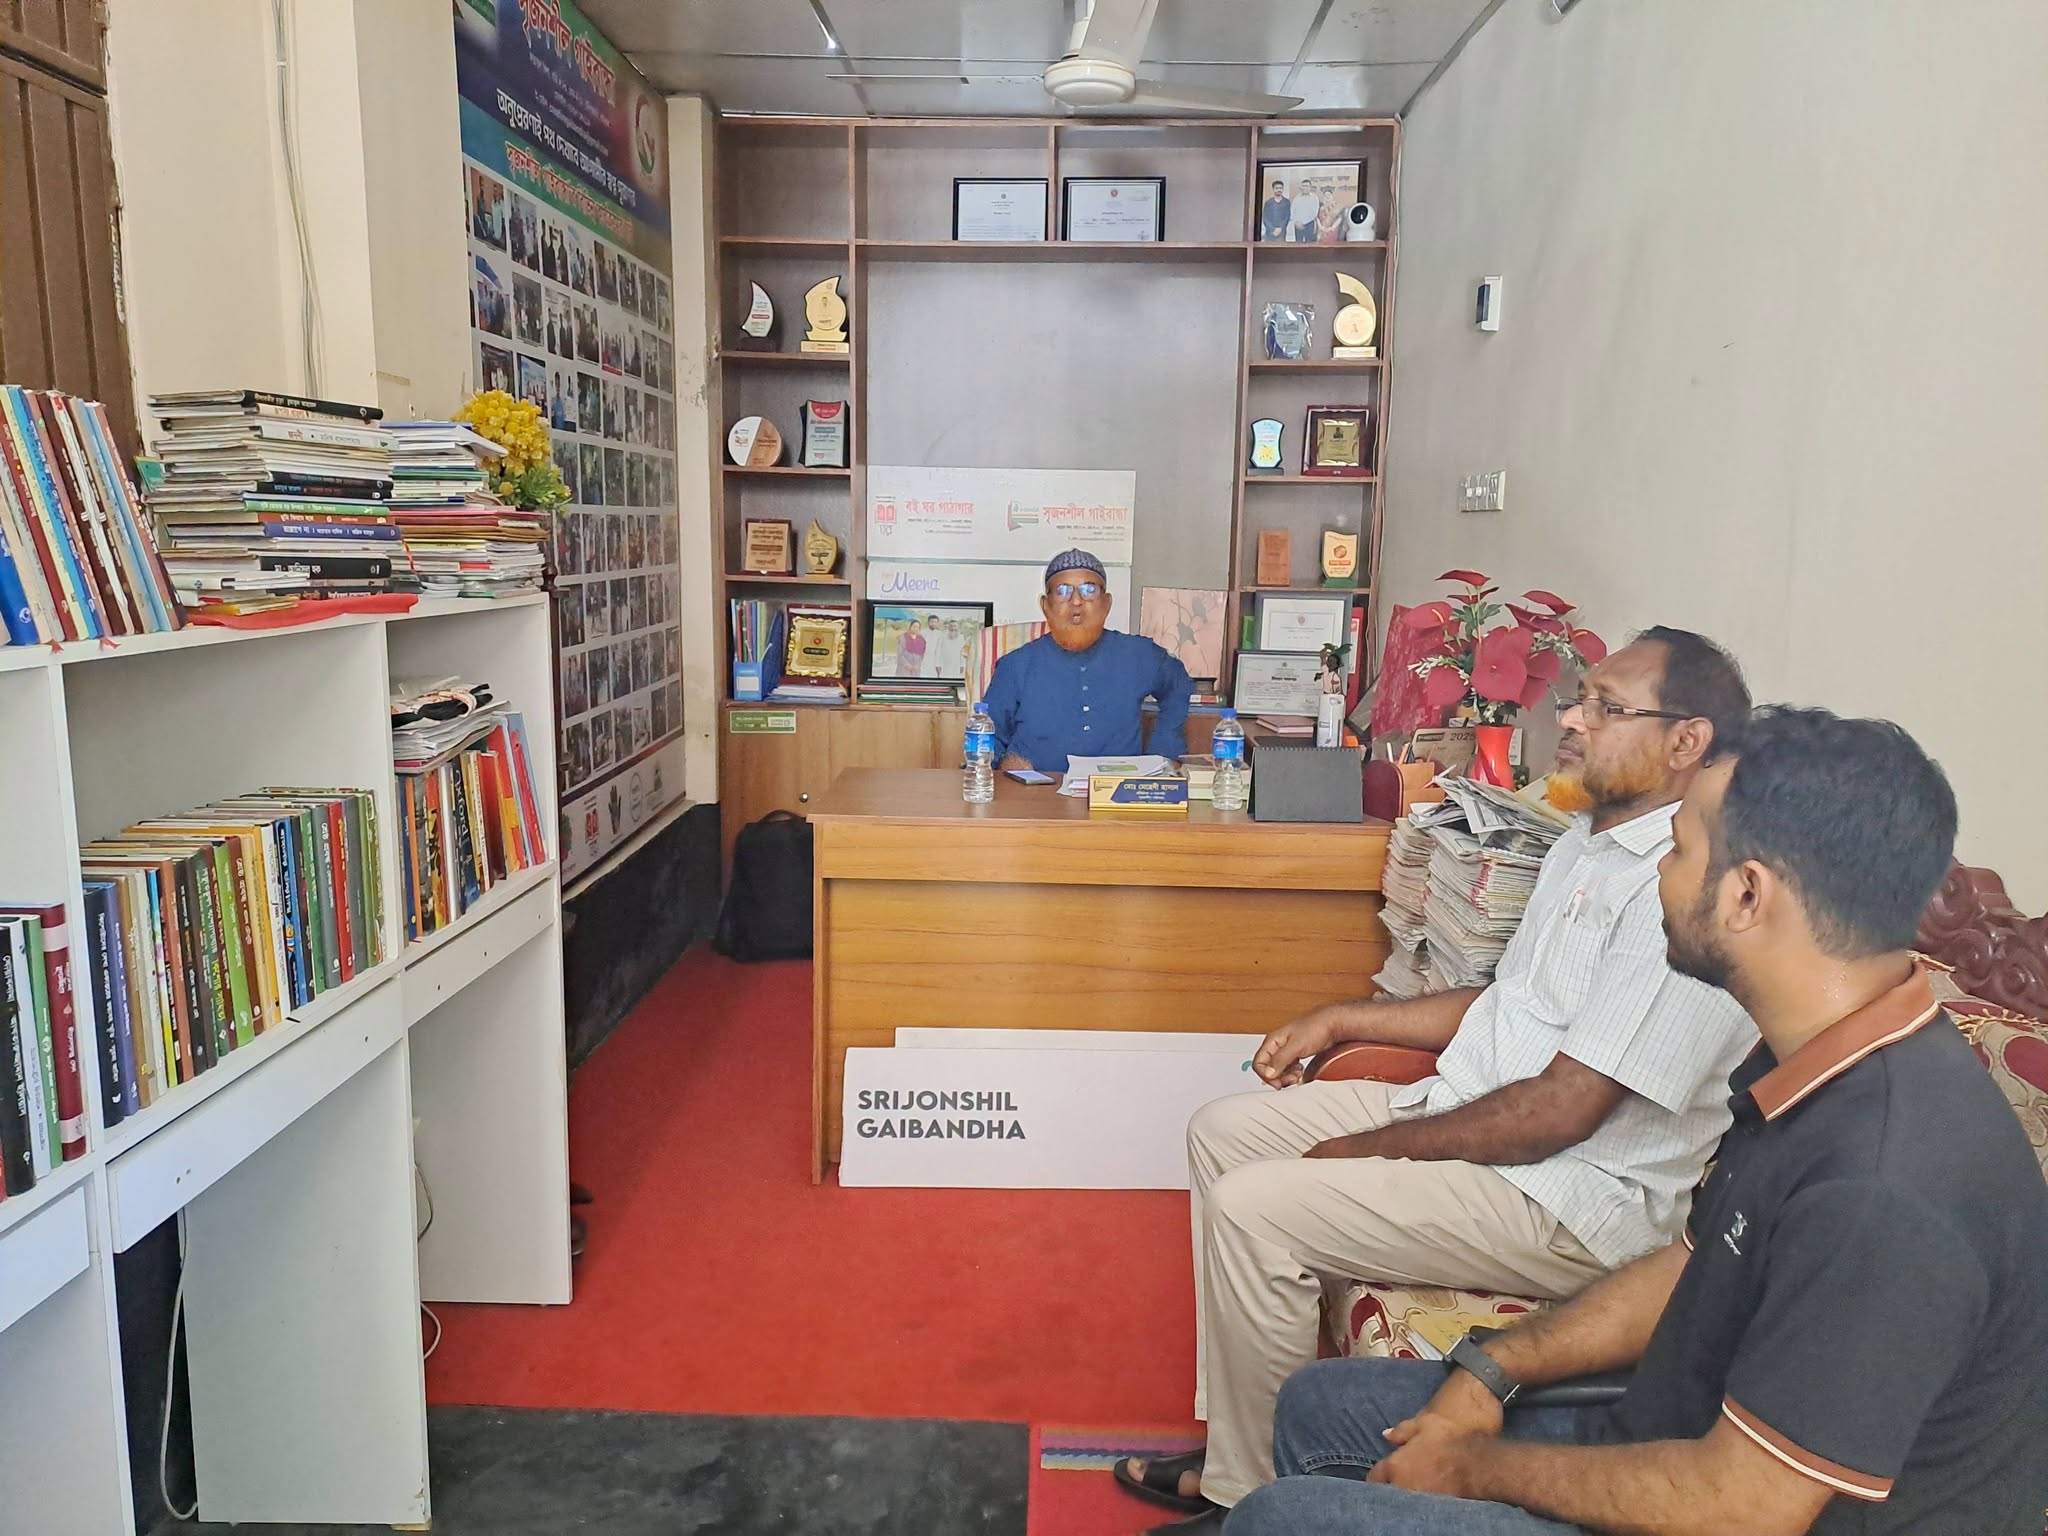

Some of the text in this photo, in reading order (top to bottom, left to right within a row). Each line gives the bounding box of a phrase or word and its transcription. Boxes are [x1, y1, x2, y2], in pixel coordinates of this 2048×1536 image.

[881, 572, 940, 593] Meena
[858, 1090, 1018, 1111] SRIJONSHIL
[856, 1118, 1026, 1139] GAIBANDHA
